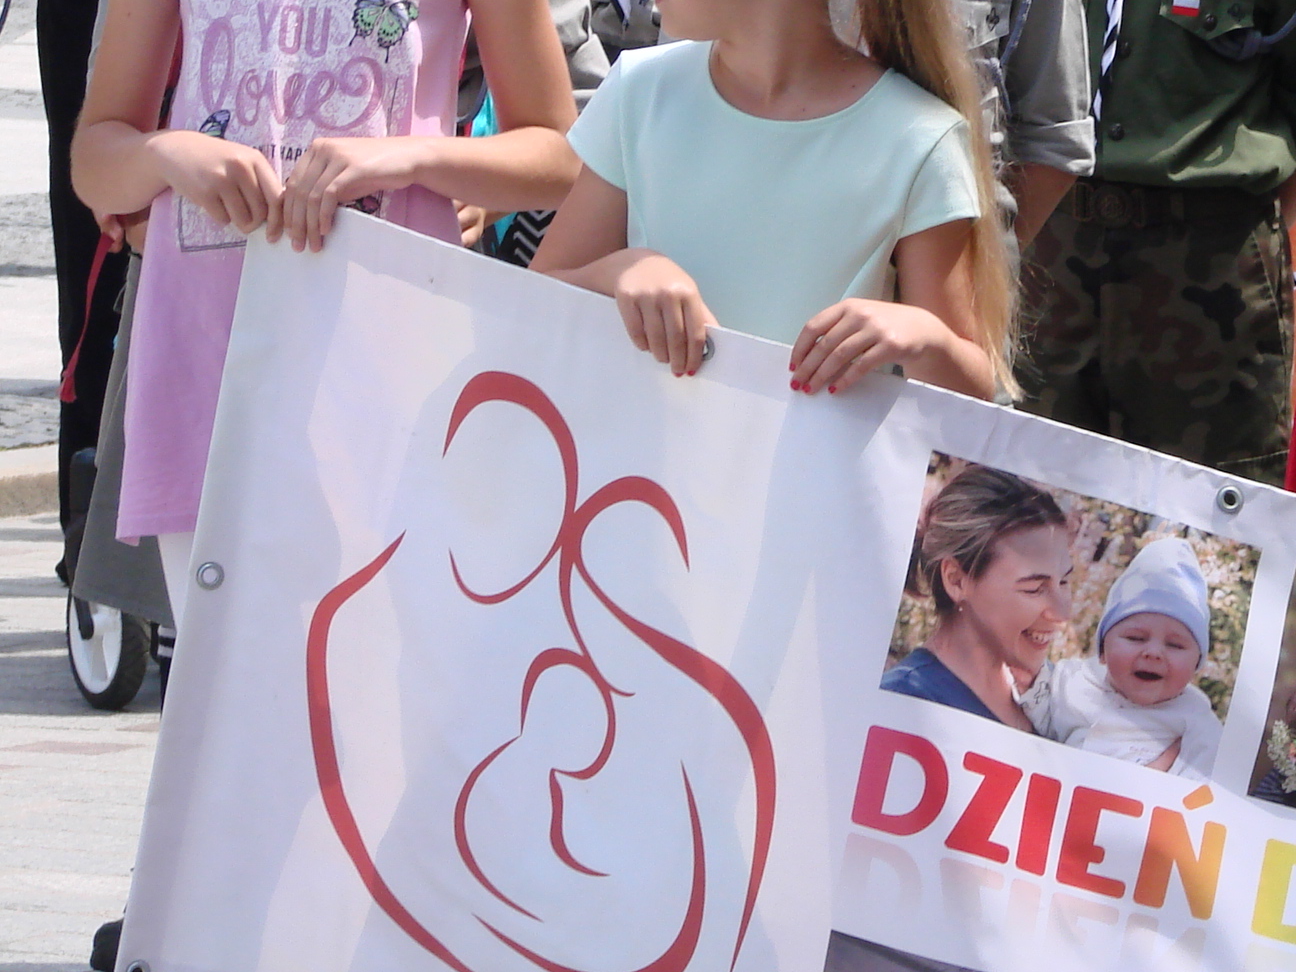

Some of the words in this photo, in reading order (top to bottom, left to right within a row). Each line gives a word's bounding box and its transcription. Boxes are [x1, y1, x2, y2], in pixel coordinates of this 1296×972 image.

[200, 16, 385, 131] love
[257, 2, 332, 58] YOU
[851, 724, 1227, 920] DZIEŃ
